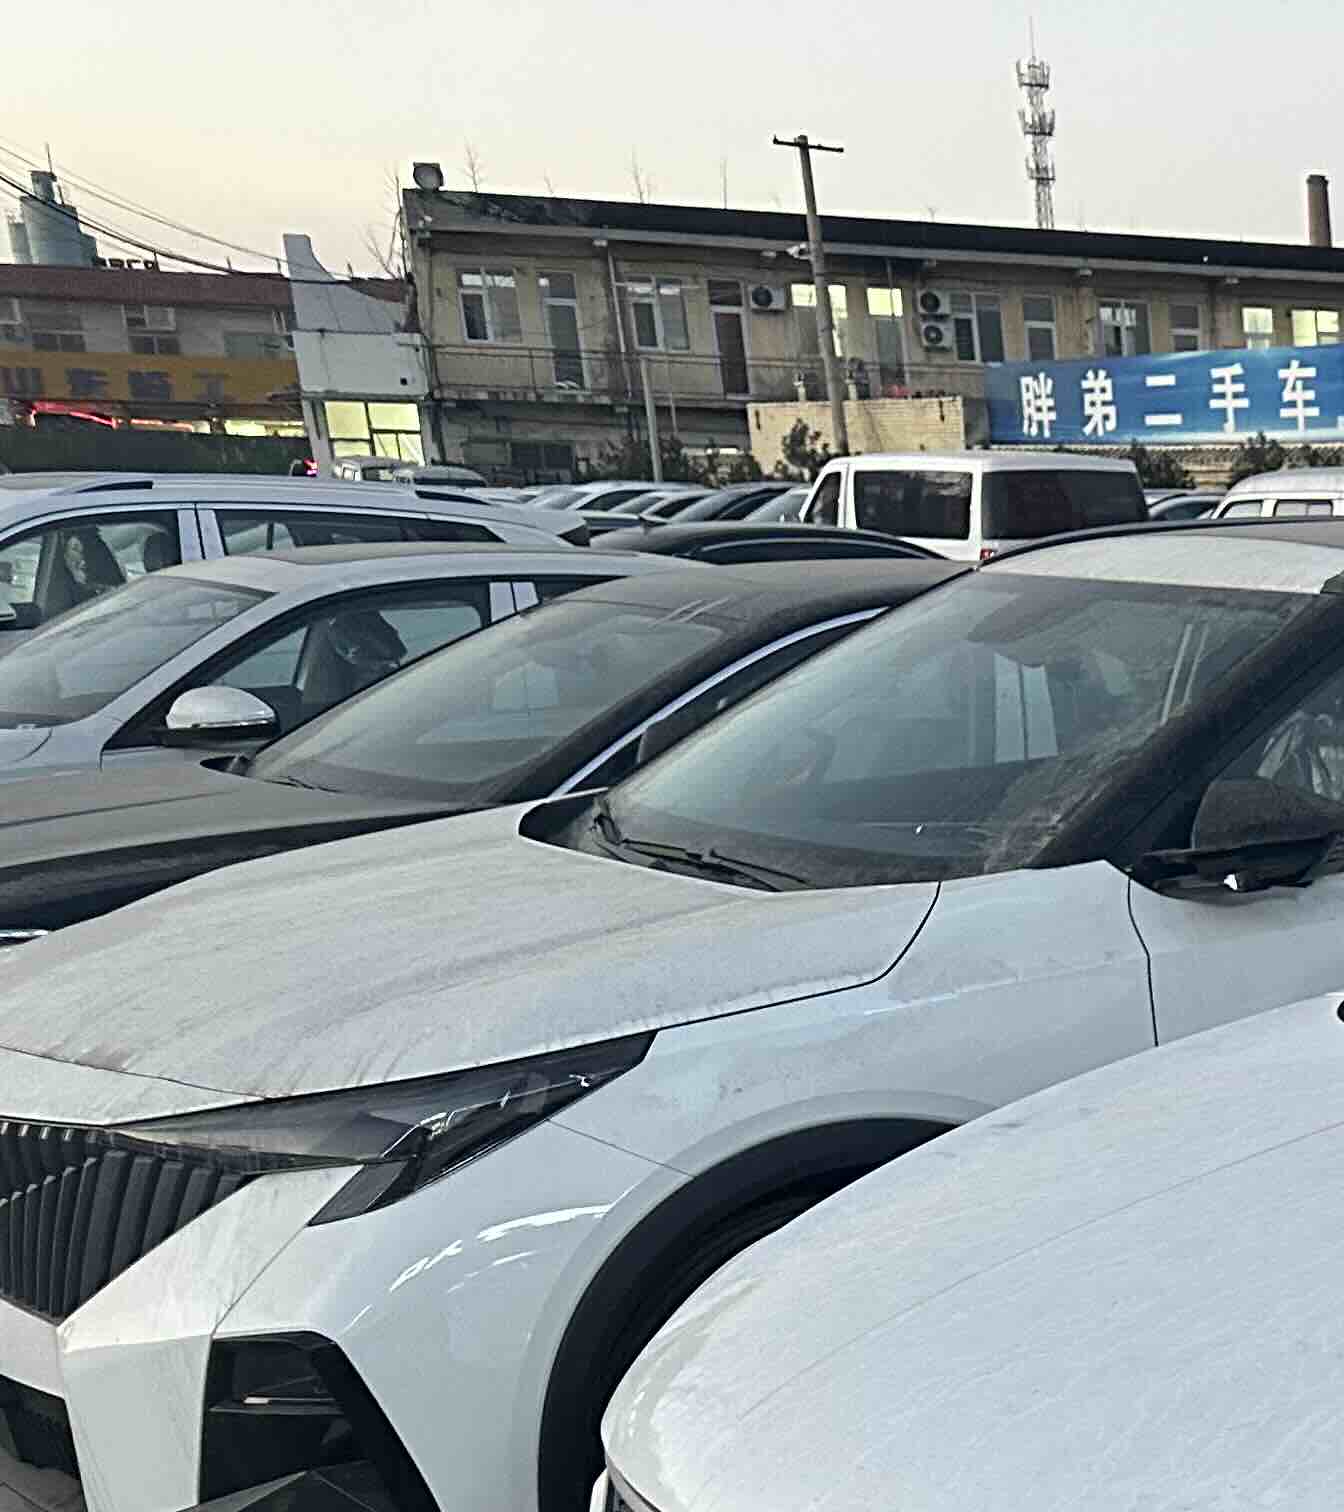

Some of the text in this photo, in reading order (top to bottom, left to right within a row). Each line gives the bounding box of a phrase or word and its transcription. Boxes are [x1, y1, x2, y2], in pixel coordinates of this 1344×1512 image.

[1020, 359, 1320, 438] 胖弟二手车
